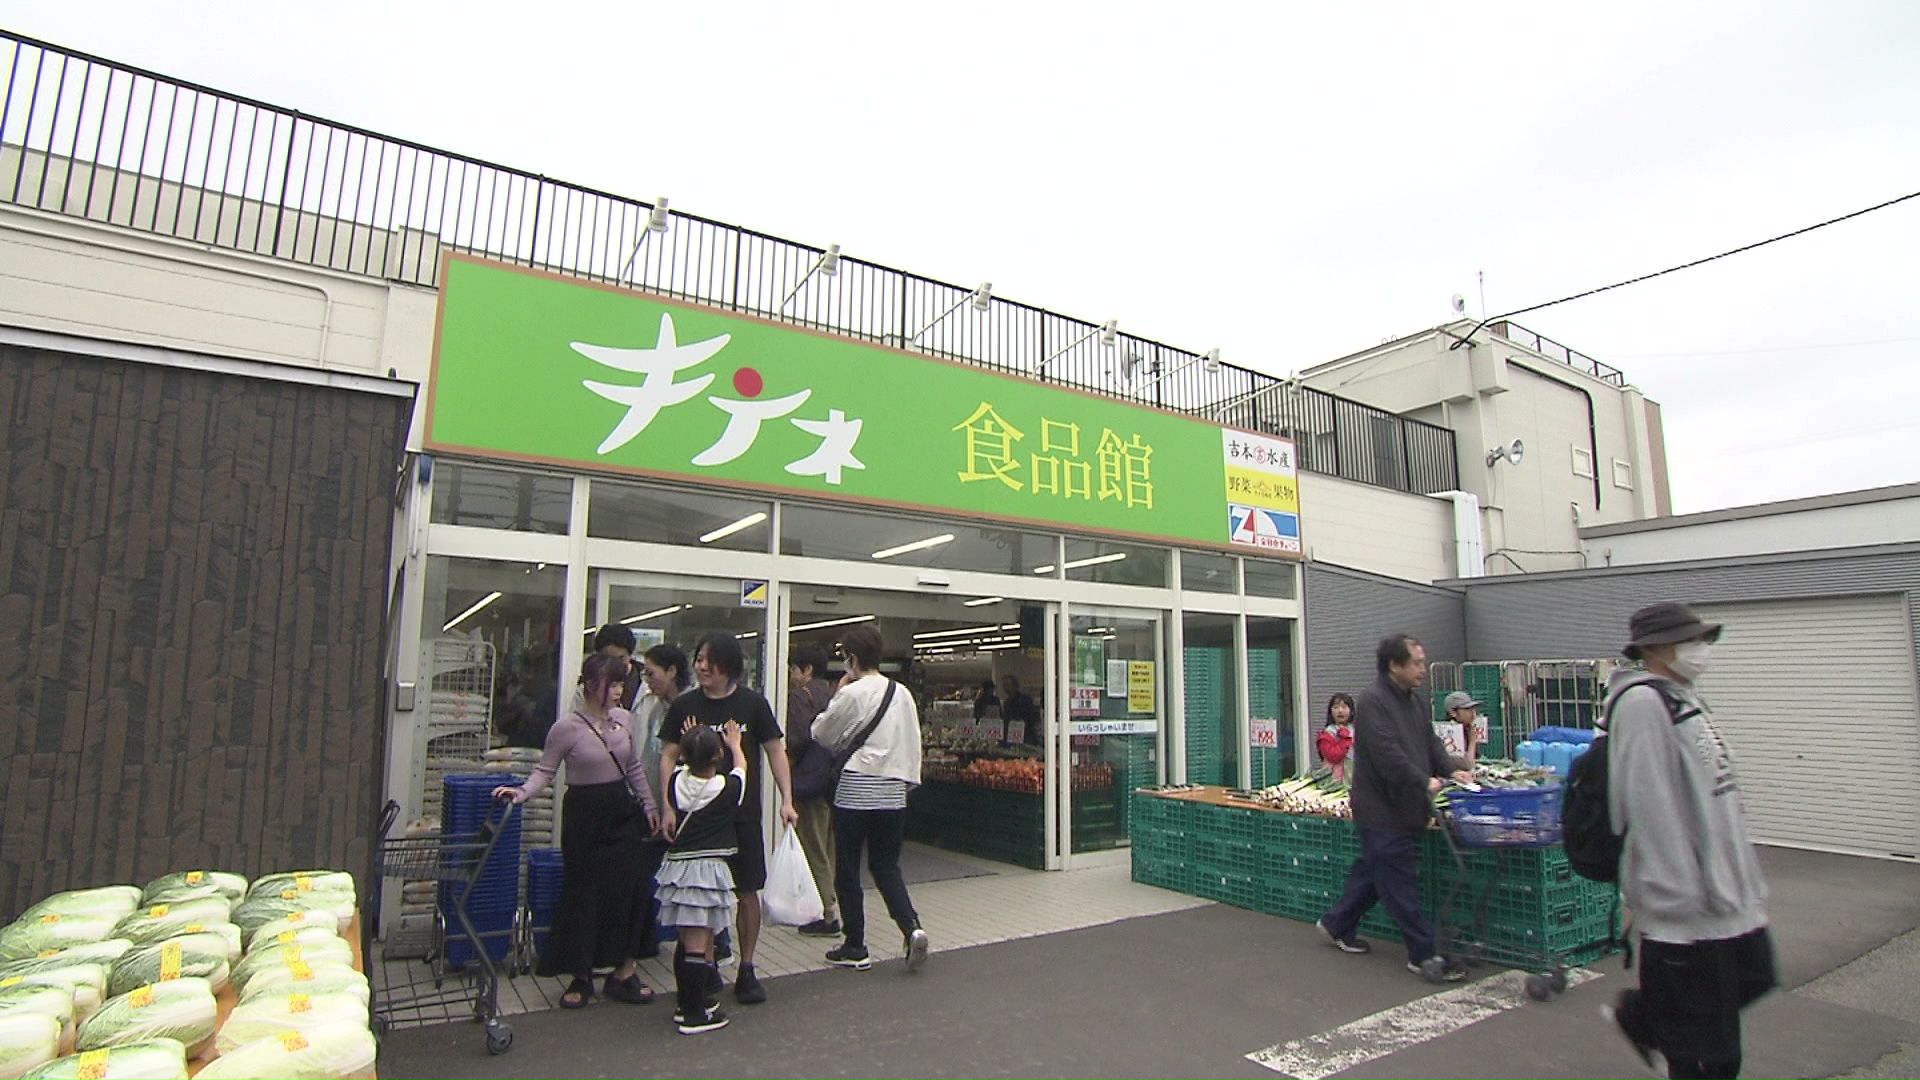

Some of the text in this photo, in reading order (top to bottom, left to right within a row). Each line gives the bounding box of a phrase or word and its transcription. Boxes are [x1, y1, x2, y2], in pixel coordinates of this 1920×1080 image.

[569, 312, 1153, 510] キテネ 食品館
[1228, 440, 1253, 460] 吉本
[1267, 448, 1290, 468] 水産
[1229, 476, 1252, 494] 野菜
[1273, 483, 1294, 502] 果物
[1078, 722, 1134, 733] いらっしゃいませ
